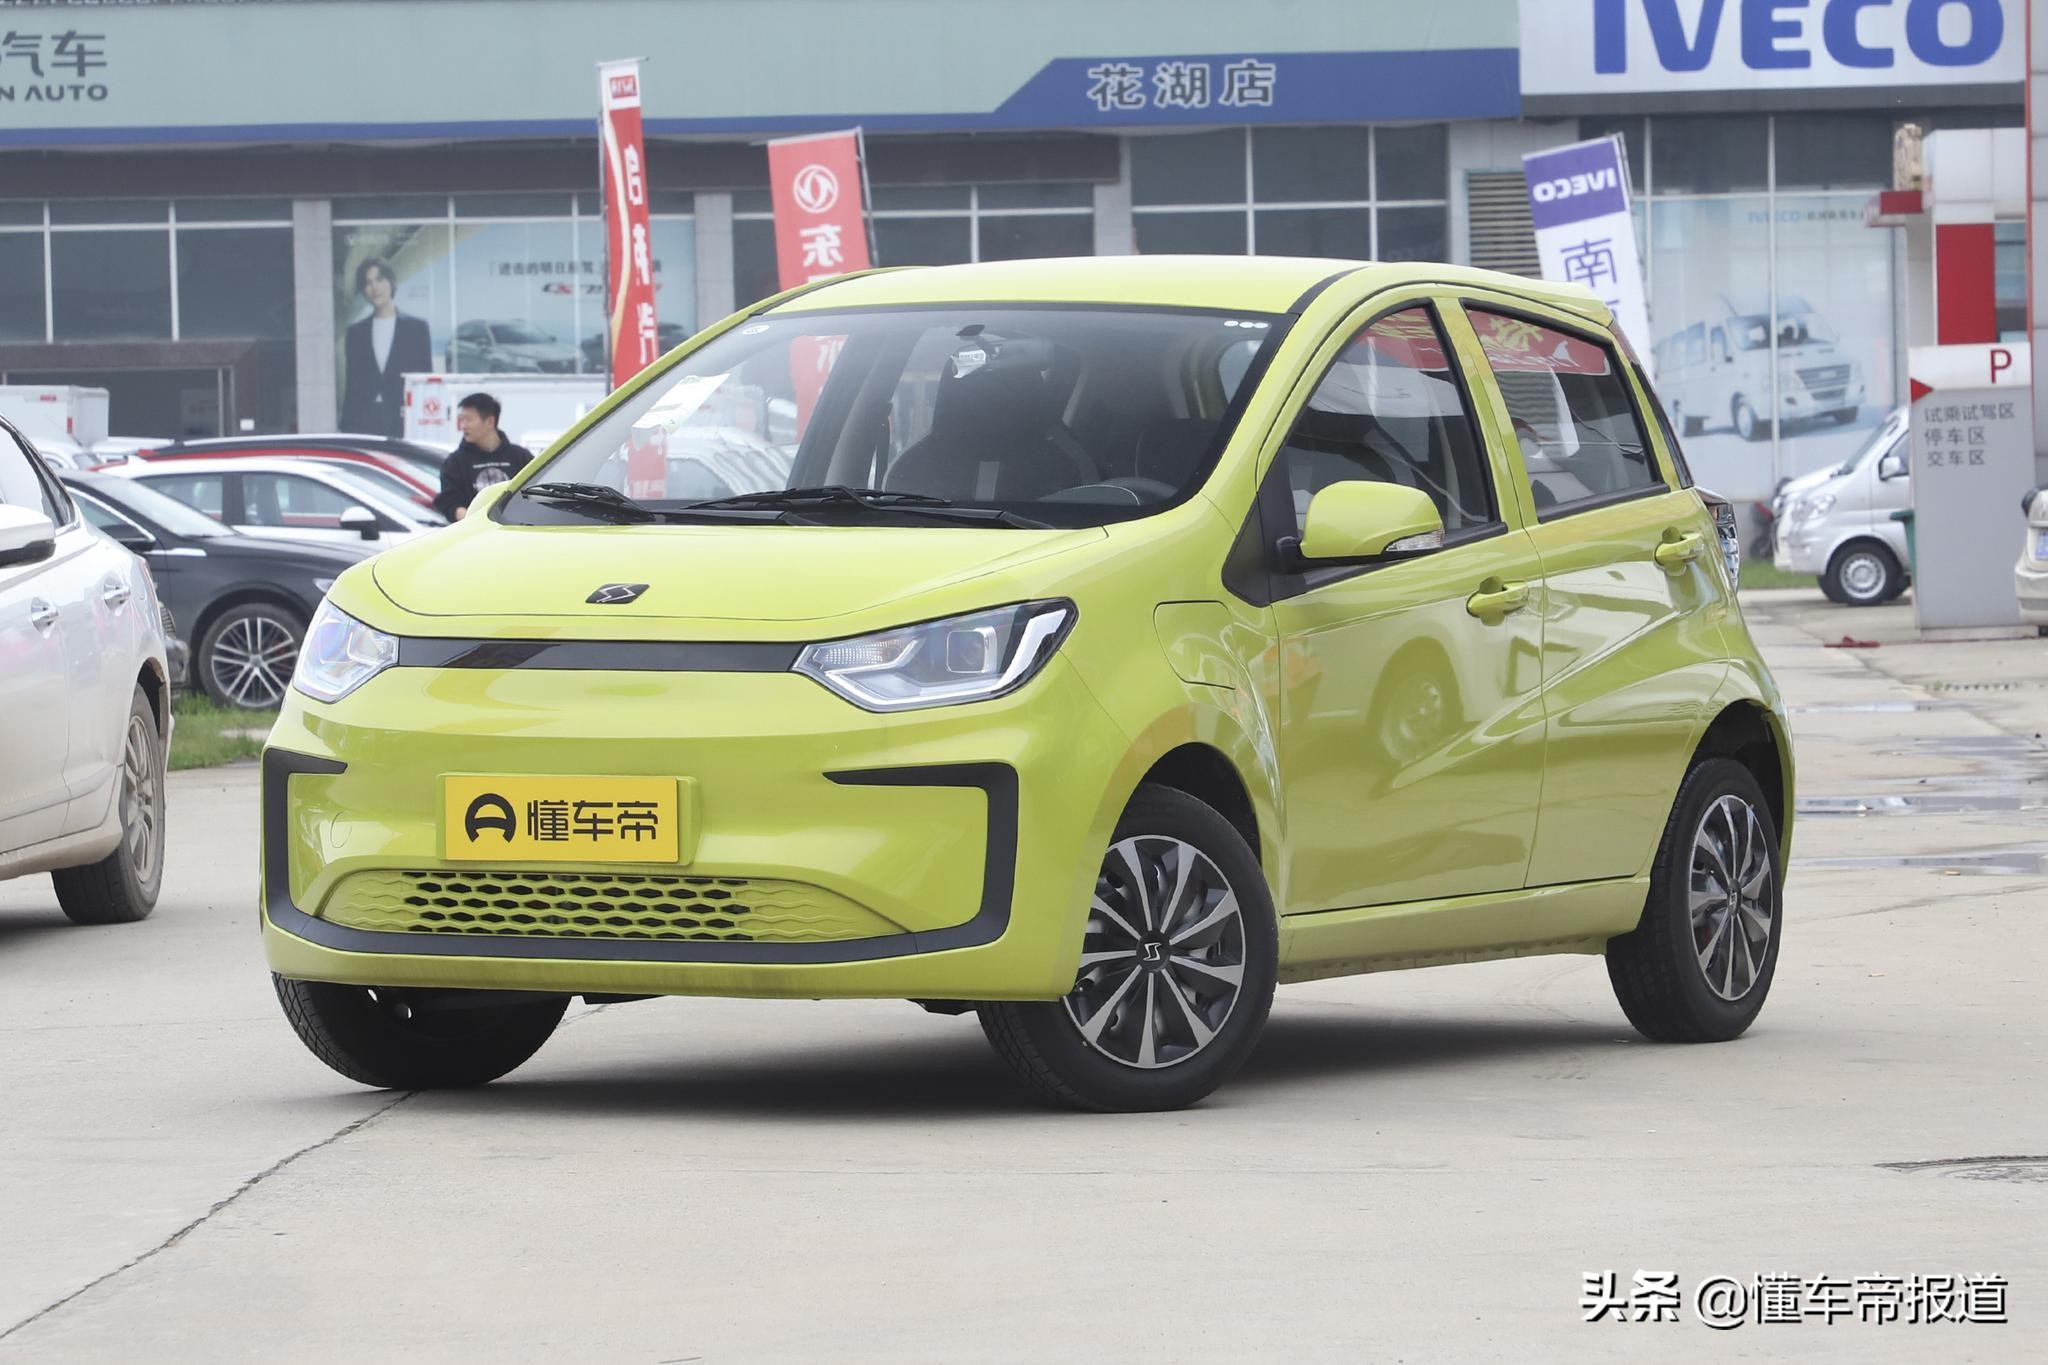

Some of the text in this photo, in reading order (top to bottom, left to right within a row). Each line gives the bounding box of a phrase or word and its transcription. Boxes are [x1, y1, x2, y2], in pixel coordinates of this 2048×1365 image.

[1595, 0, 2004, 73] IVECO
[25, 84, 108, 101] AUTO
[1087, 59, 1276, 111] 花湖店
[1990, 349, 2012, 384] P
[1924, 426, 1985, 446] 停车区
[1927, 449, 1985, 467] 交车区
[527, 800, 658, 842] 懂车帝
